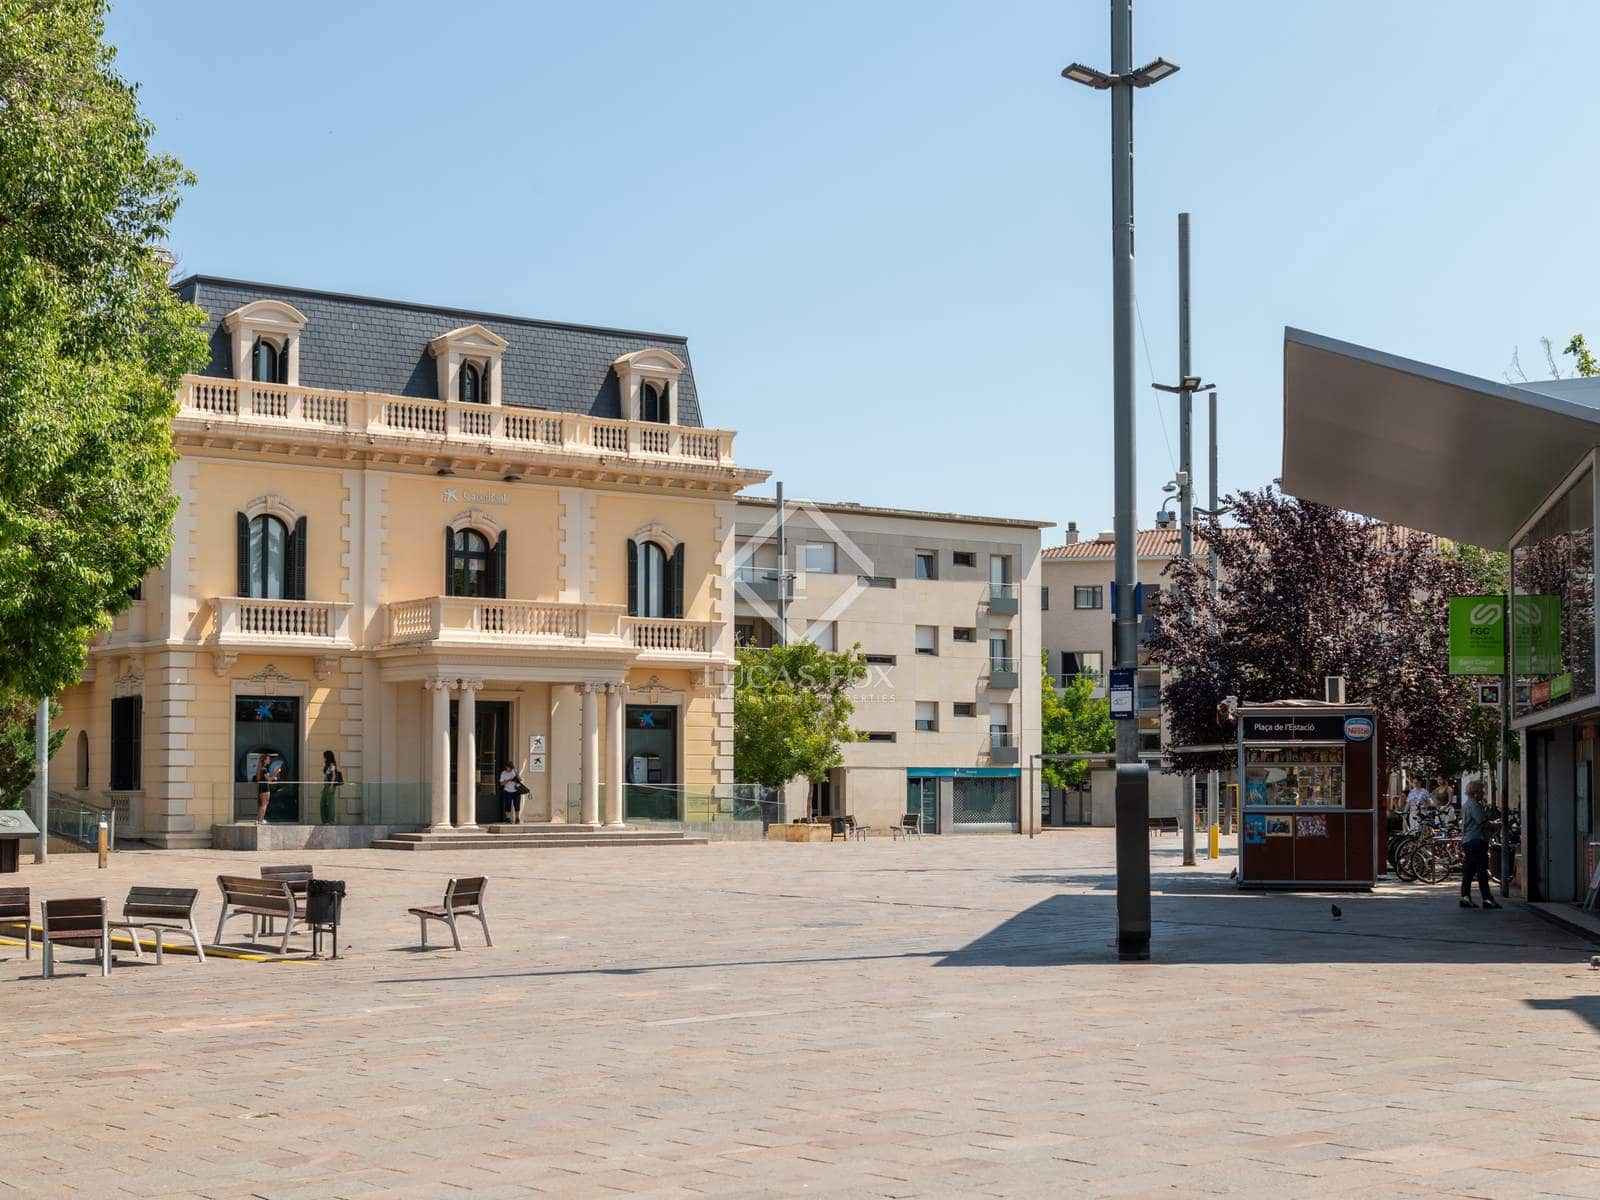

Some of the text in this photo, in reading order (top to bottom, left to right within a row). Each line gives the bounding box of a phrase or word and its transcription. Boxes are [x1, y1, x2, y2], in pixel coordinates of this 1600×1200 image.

[1470, 627, 1490, 635] FGC
[1254, 722, 1273, 732] Plaça
[1274, 722, 1284, 731] de
